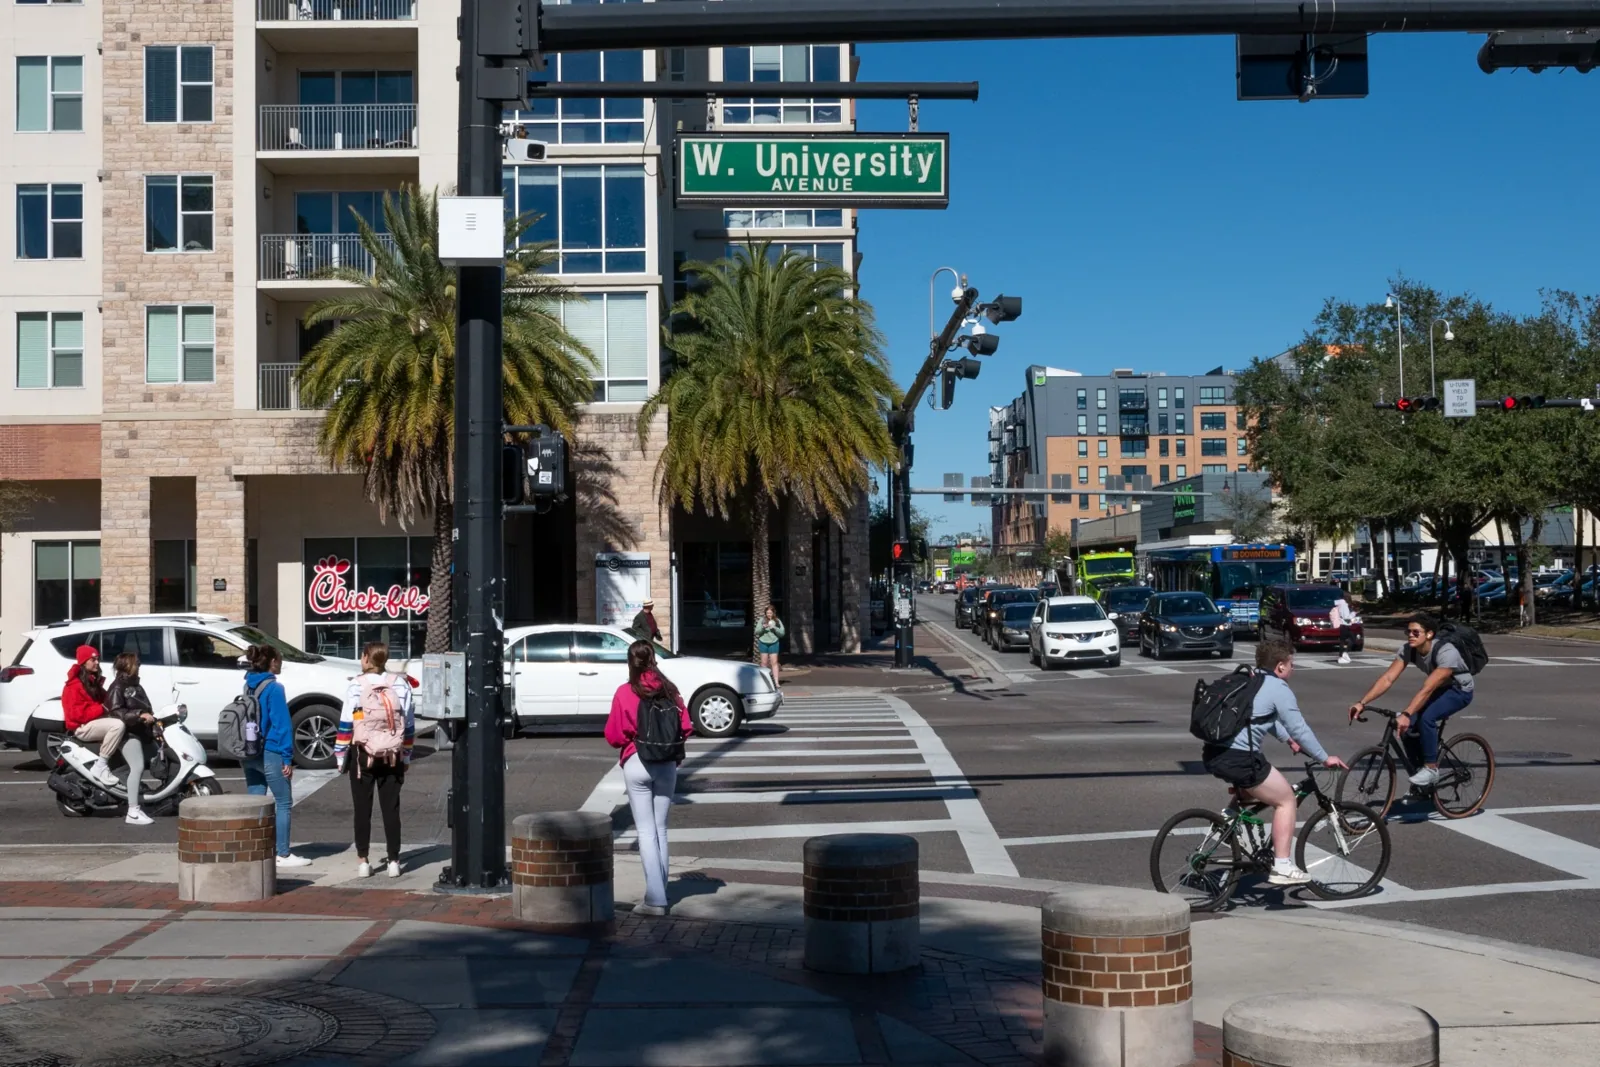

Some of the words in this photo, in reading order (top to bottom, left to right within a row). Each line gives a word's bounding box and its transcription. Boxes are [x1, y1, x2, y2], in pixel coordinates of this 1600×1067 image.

[692, 143, 735, 176] W.
[756, 143, 934, 184] University
[771, 177, 853, 191] AVENUE
